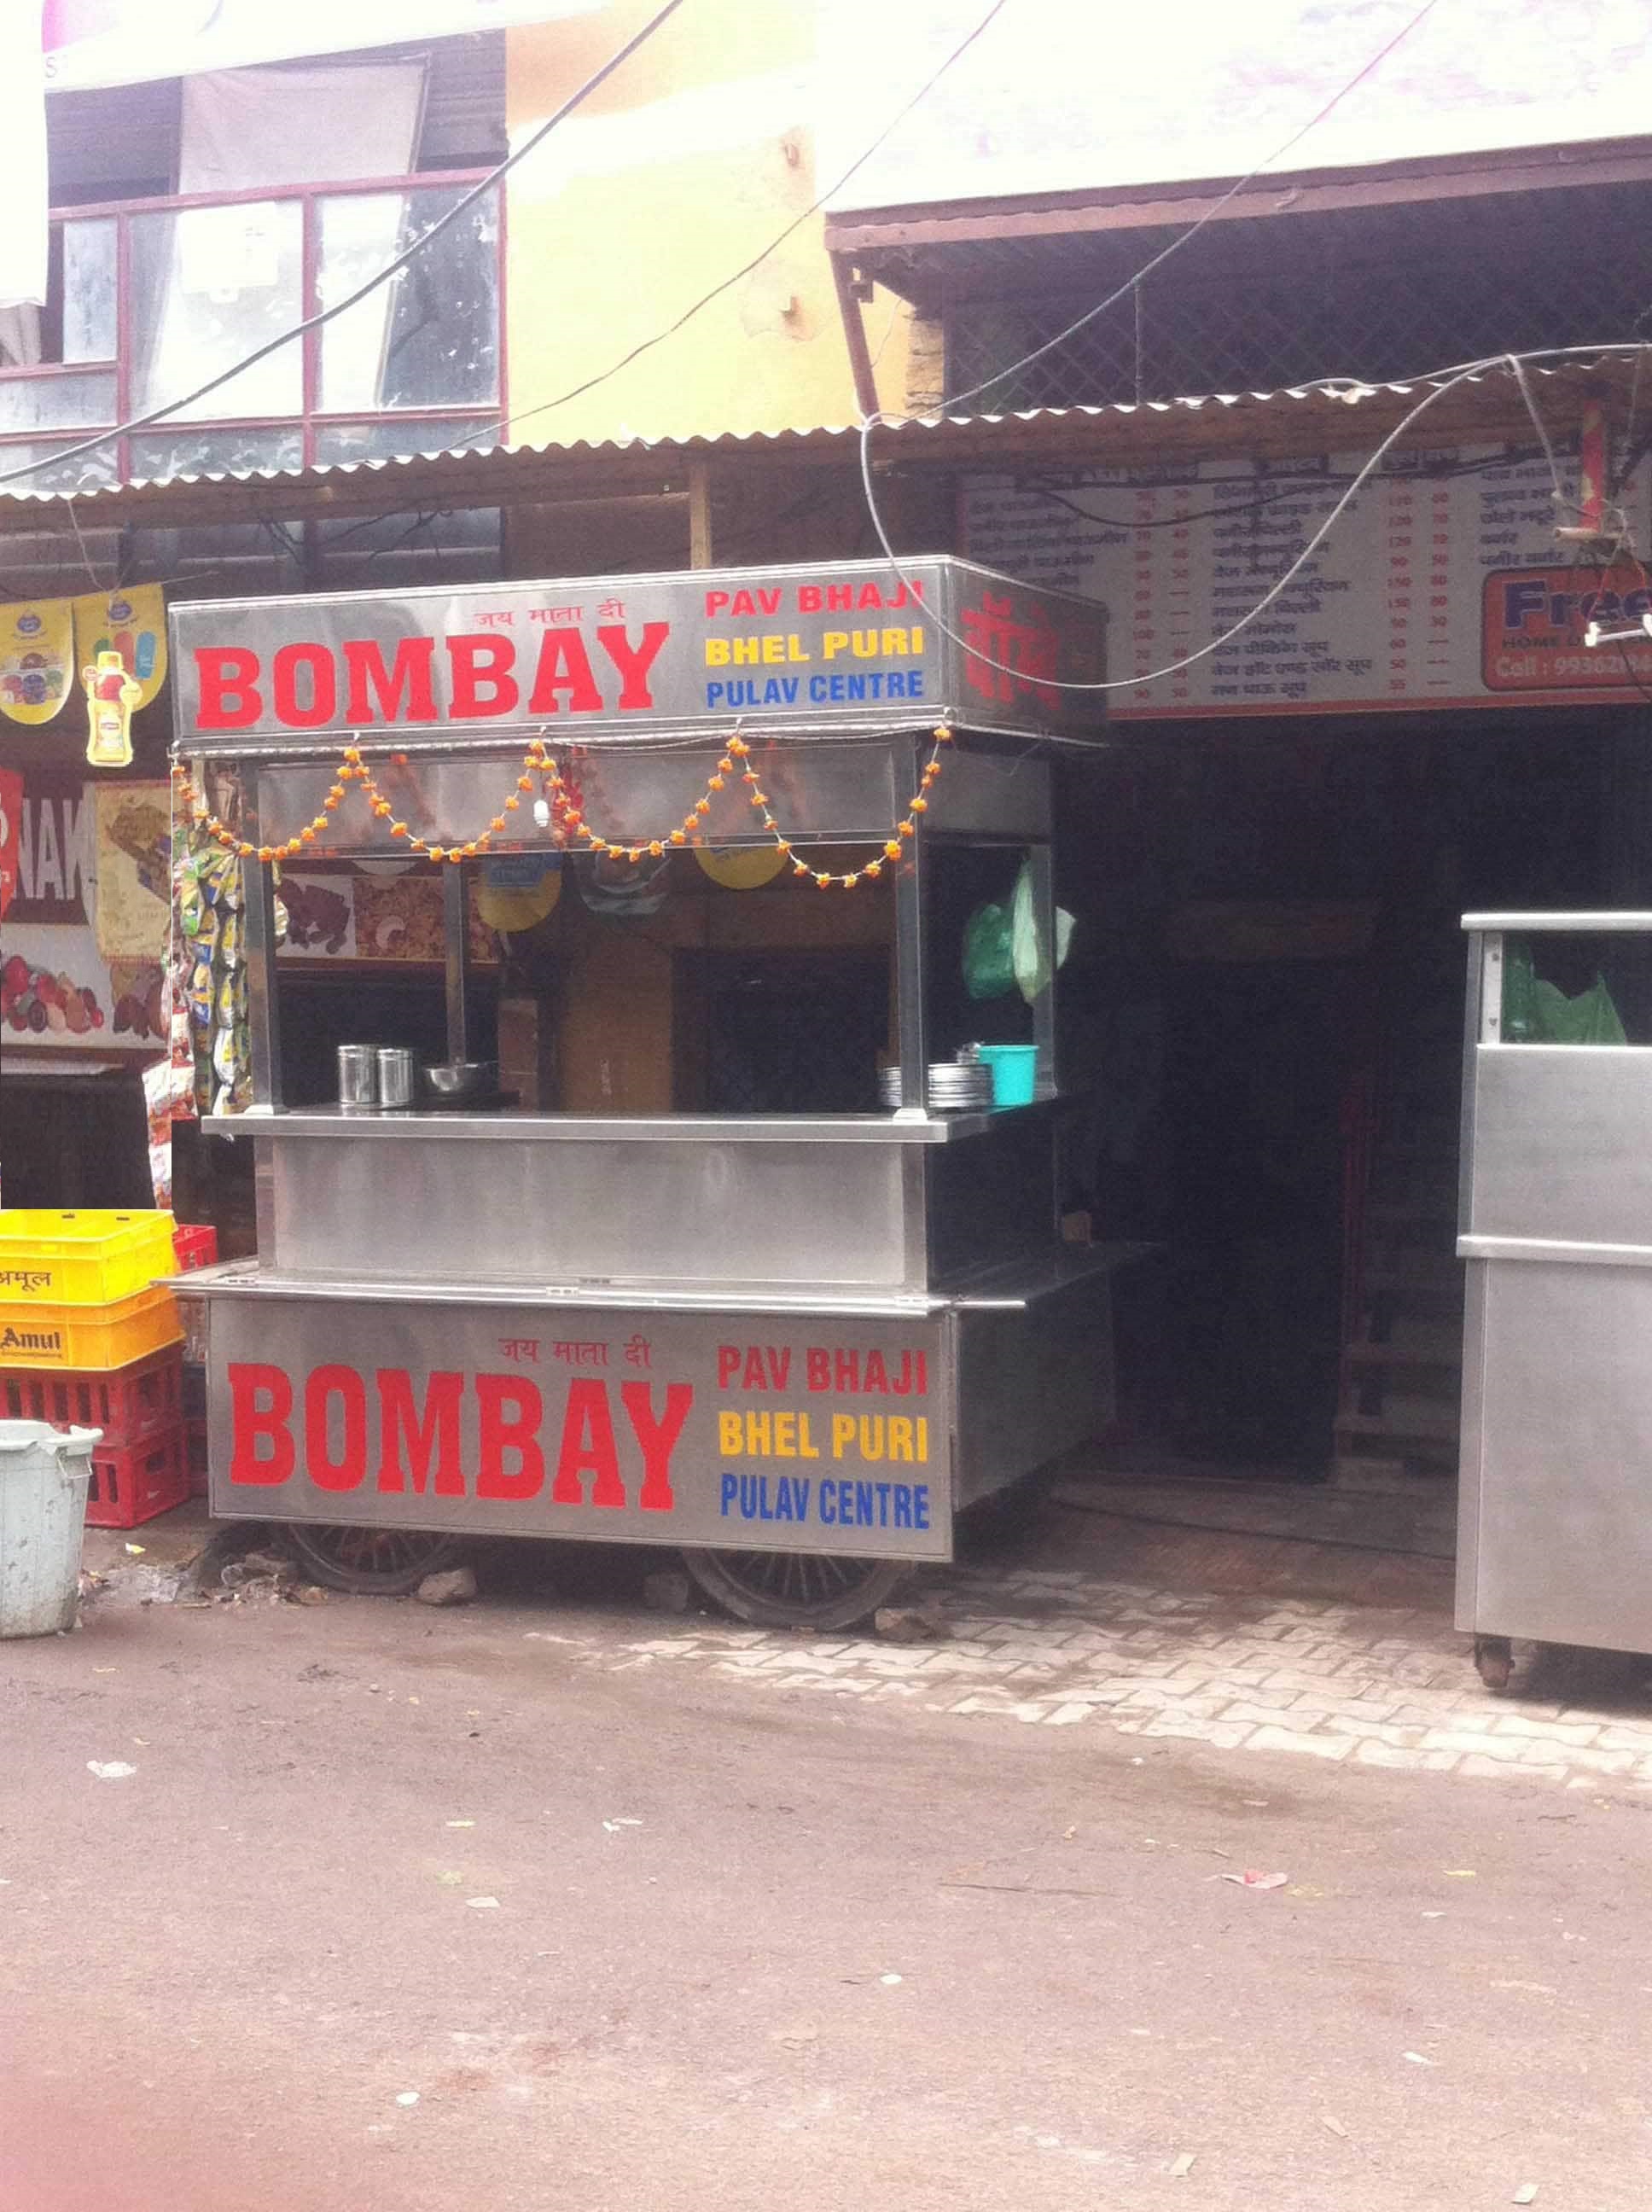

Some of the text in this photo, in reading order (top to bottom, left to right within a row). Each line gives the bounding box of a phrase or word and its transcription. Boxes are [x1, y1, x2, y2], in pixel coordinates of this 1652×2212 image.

[474, 597, 626, 630] जय माता दी
[705, 579, 924, 619] PAV BHAJI
[705, 626, 924, 667] BHEL PURI
[1502, 635, 1561, 649] HOME
[194, 622, 670, 731] BOMBAY
[1495, 655, 1536, 677] Call
[707, 670, 924, 709] PULAV CENTRE
[0, 1327, 61, 1350] Amul
[498, 1333, 651, 1368] जय माता दी
[717, 1345, 928, 1395] PAV BHAJI
[227, 1362, 694, 1512] BOMBAY
[718, 1411, 928, 1462] BHEL PURI
[720, 1472, 929, 1530] PULAV CENTRE
